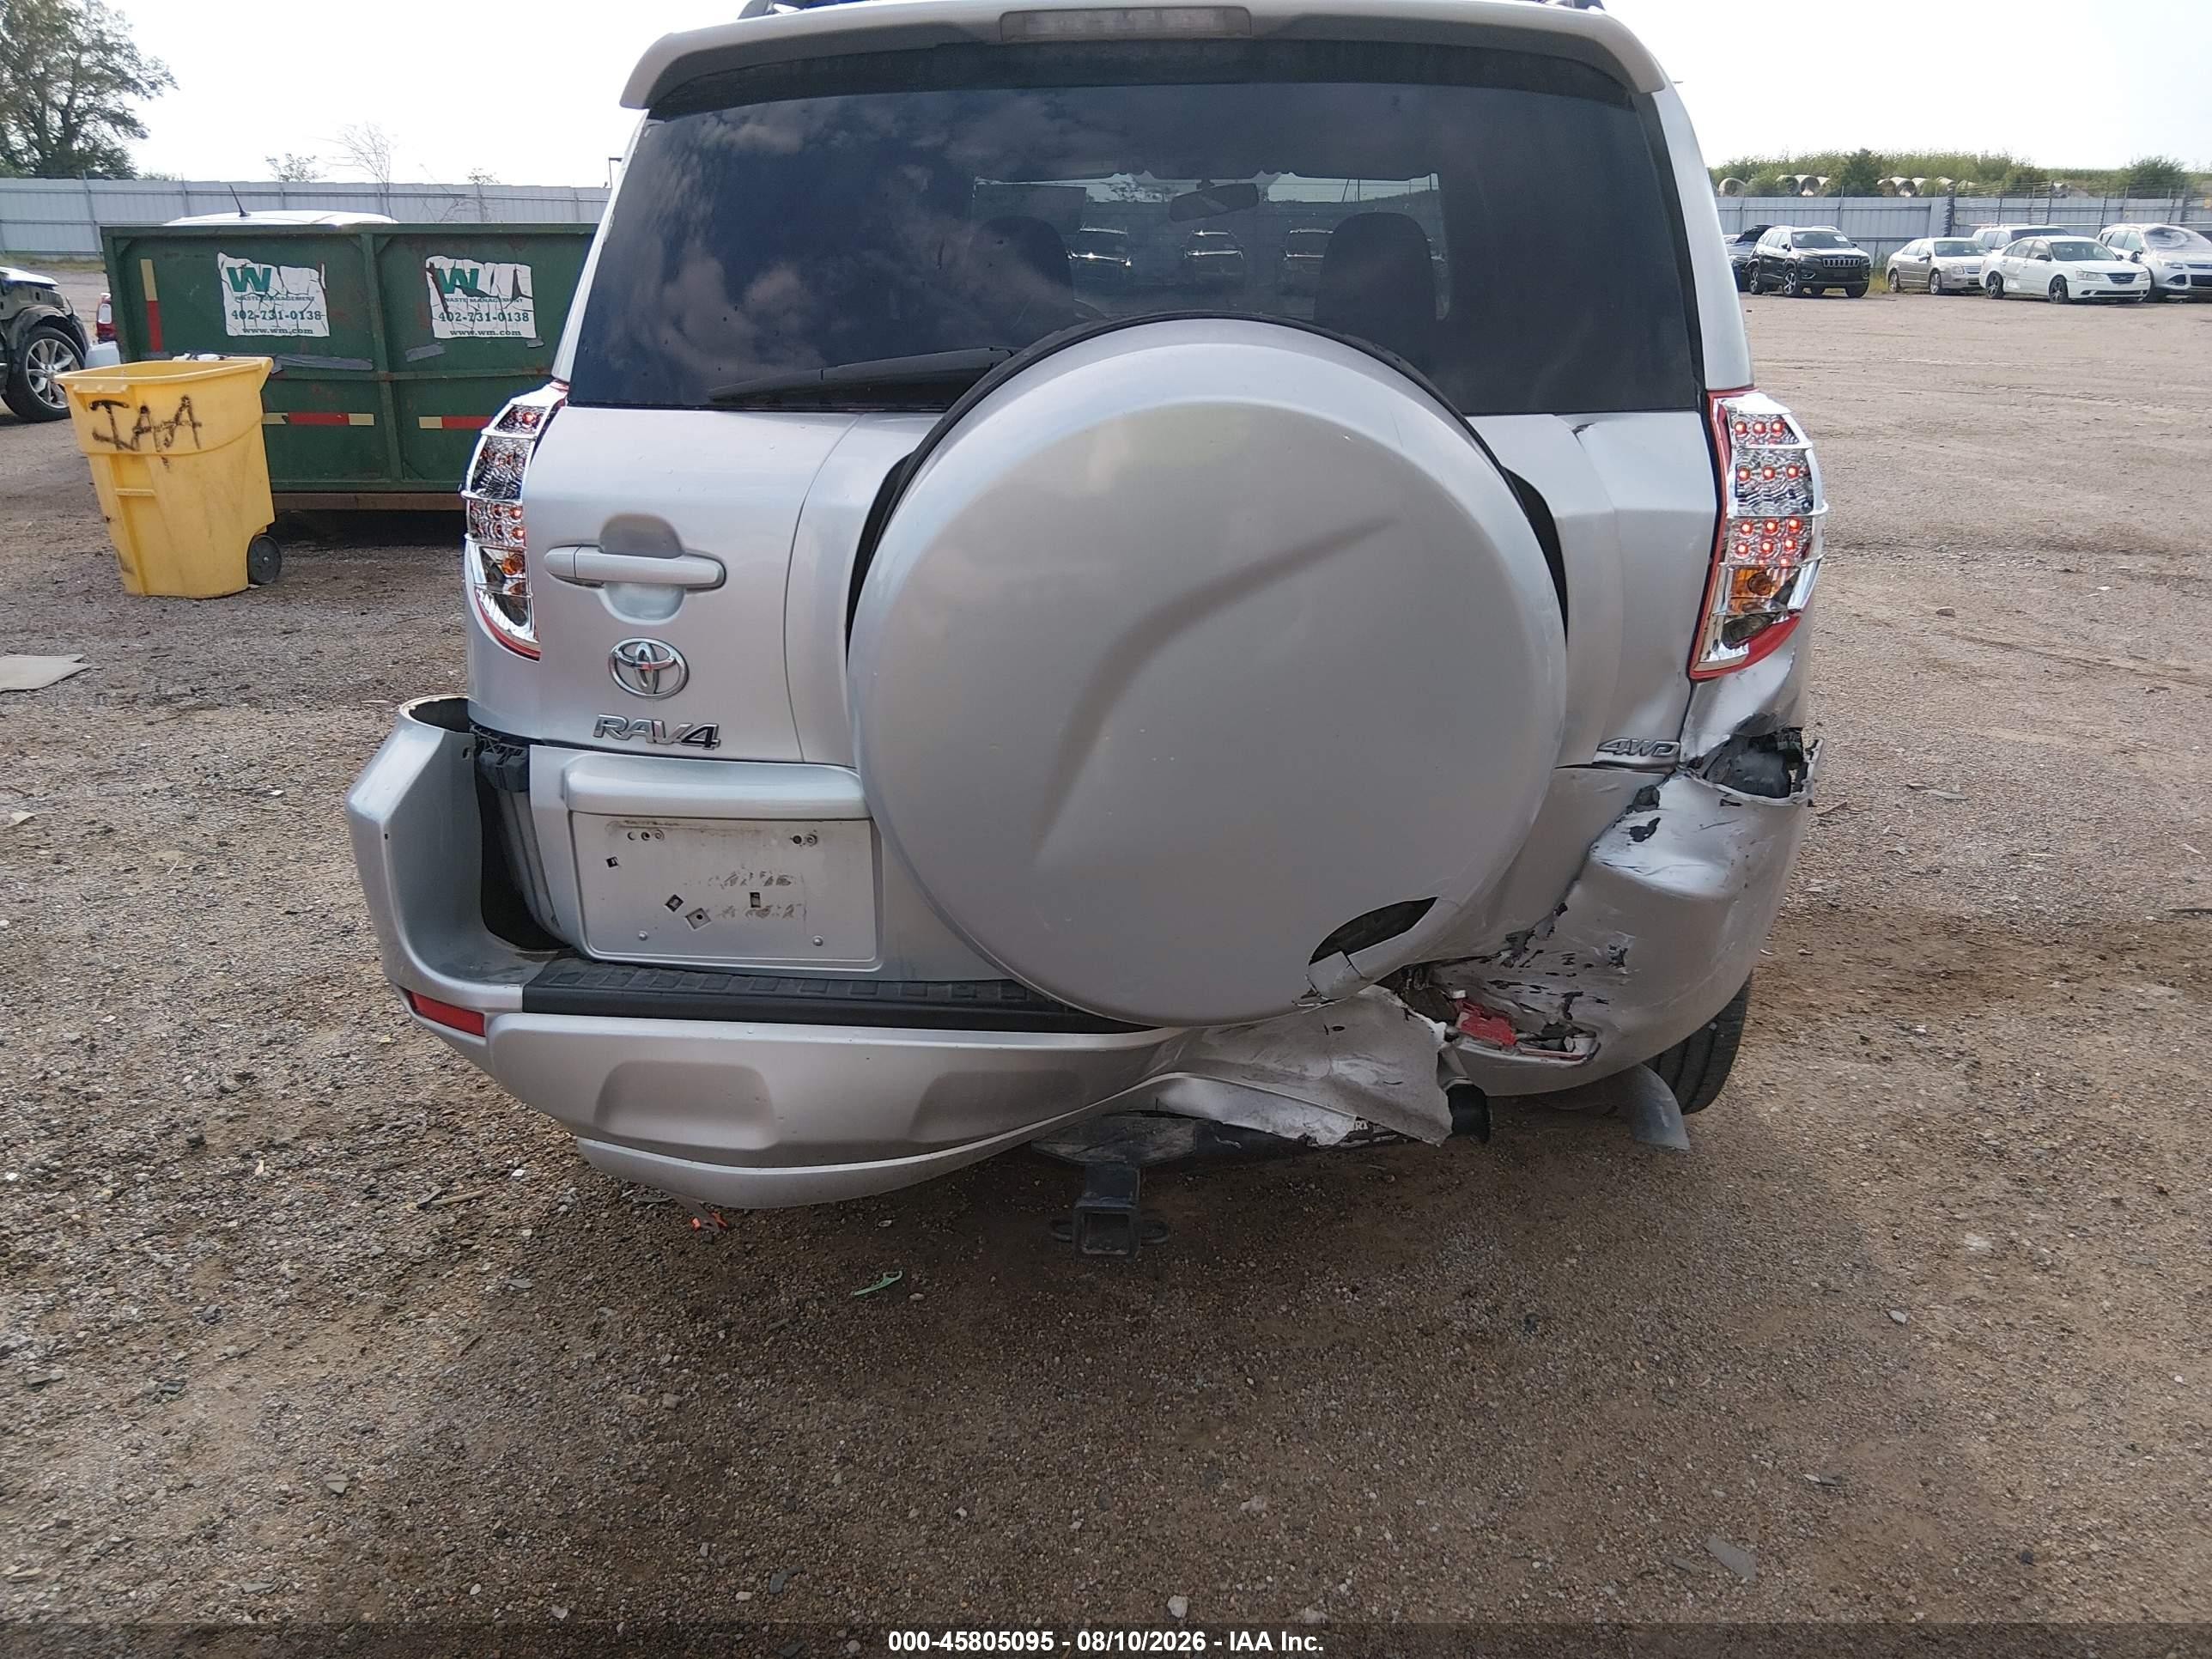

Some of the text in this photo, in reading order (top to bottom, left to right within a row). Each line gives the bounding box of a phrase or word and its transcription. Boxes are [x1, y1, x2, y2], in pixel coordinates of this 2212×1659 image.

[232, 310, 322, 320] 402-731-0138
[438, 312, 530, 322] 402-731-0138
[593, 714, 721, 750] RAV4
[1598, 738, 1680, 757] 4WD
